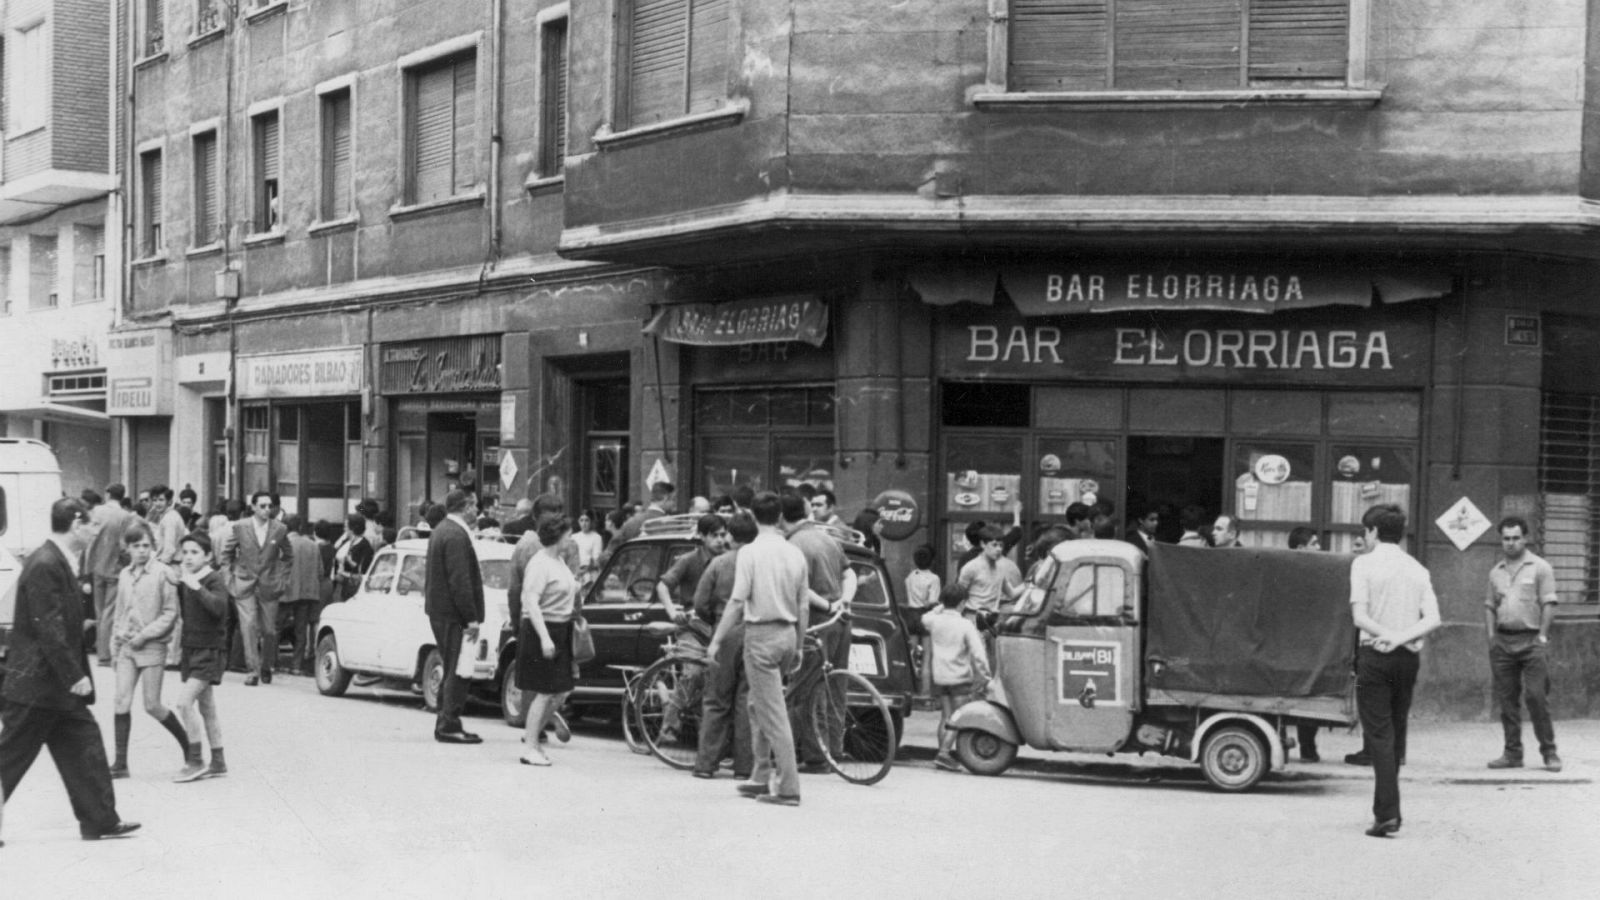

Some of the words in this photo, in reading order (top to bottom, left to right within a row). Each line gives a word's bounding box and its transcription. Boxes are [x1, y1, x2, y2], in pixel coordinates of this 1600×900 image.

[1046, 274, 1106, 302] BAR
[1126, 274, 1304, 302] ELORRIAGA
[714, 302, 811, 335] ELORRIAG
[966, 325, 1065, 364] BAR
[1112, 327, 1394, 370] ELORRIAGA
[254, 363, 311, 385] RADIADORES
[314, 361, 346, 383] BILBAO
[111, 377, 152, 408] PIRELLI
